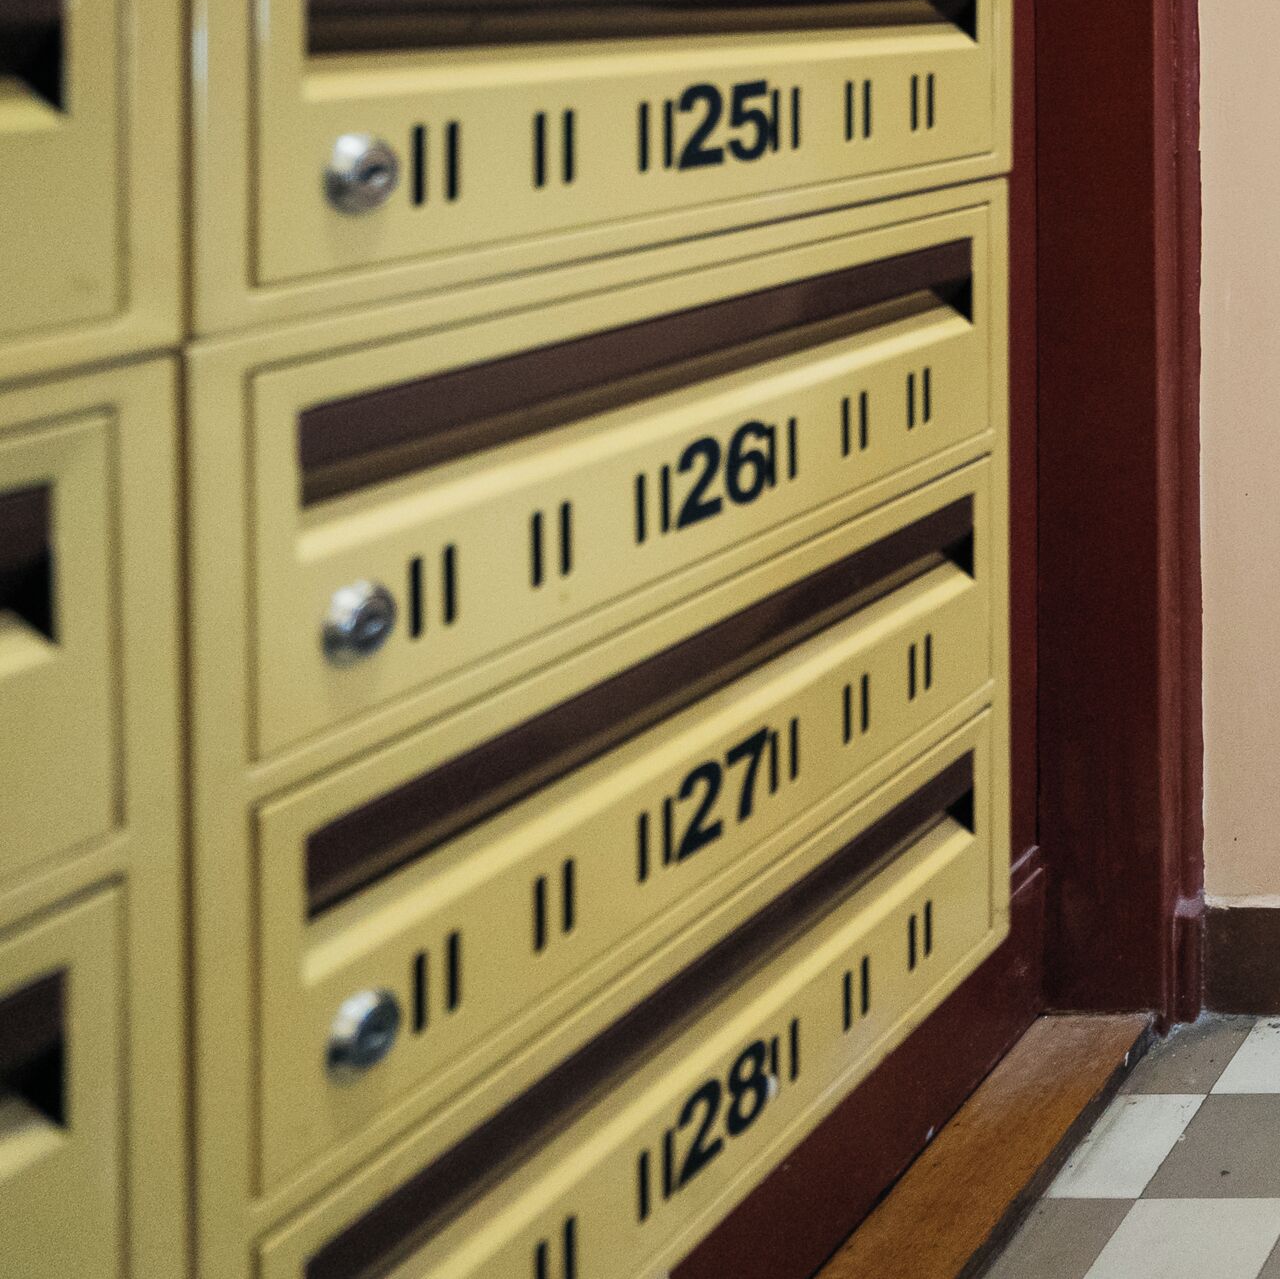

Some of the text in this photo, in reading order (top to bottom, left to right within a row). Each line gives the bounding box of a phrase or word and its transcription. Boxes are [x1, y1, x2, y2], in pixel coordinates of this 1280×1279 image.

[677, 79, 771, 172] 25
[676, 421, 770, 531] 26
[674, 726, 768, 863] 27
[674, 1040, 768, 1188] 28
